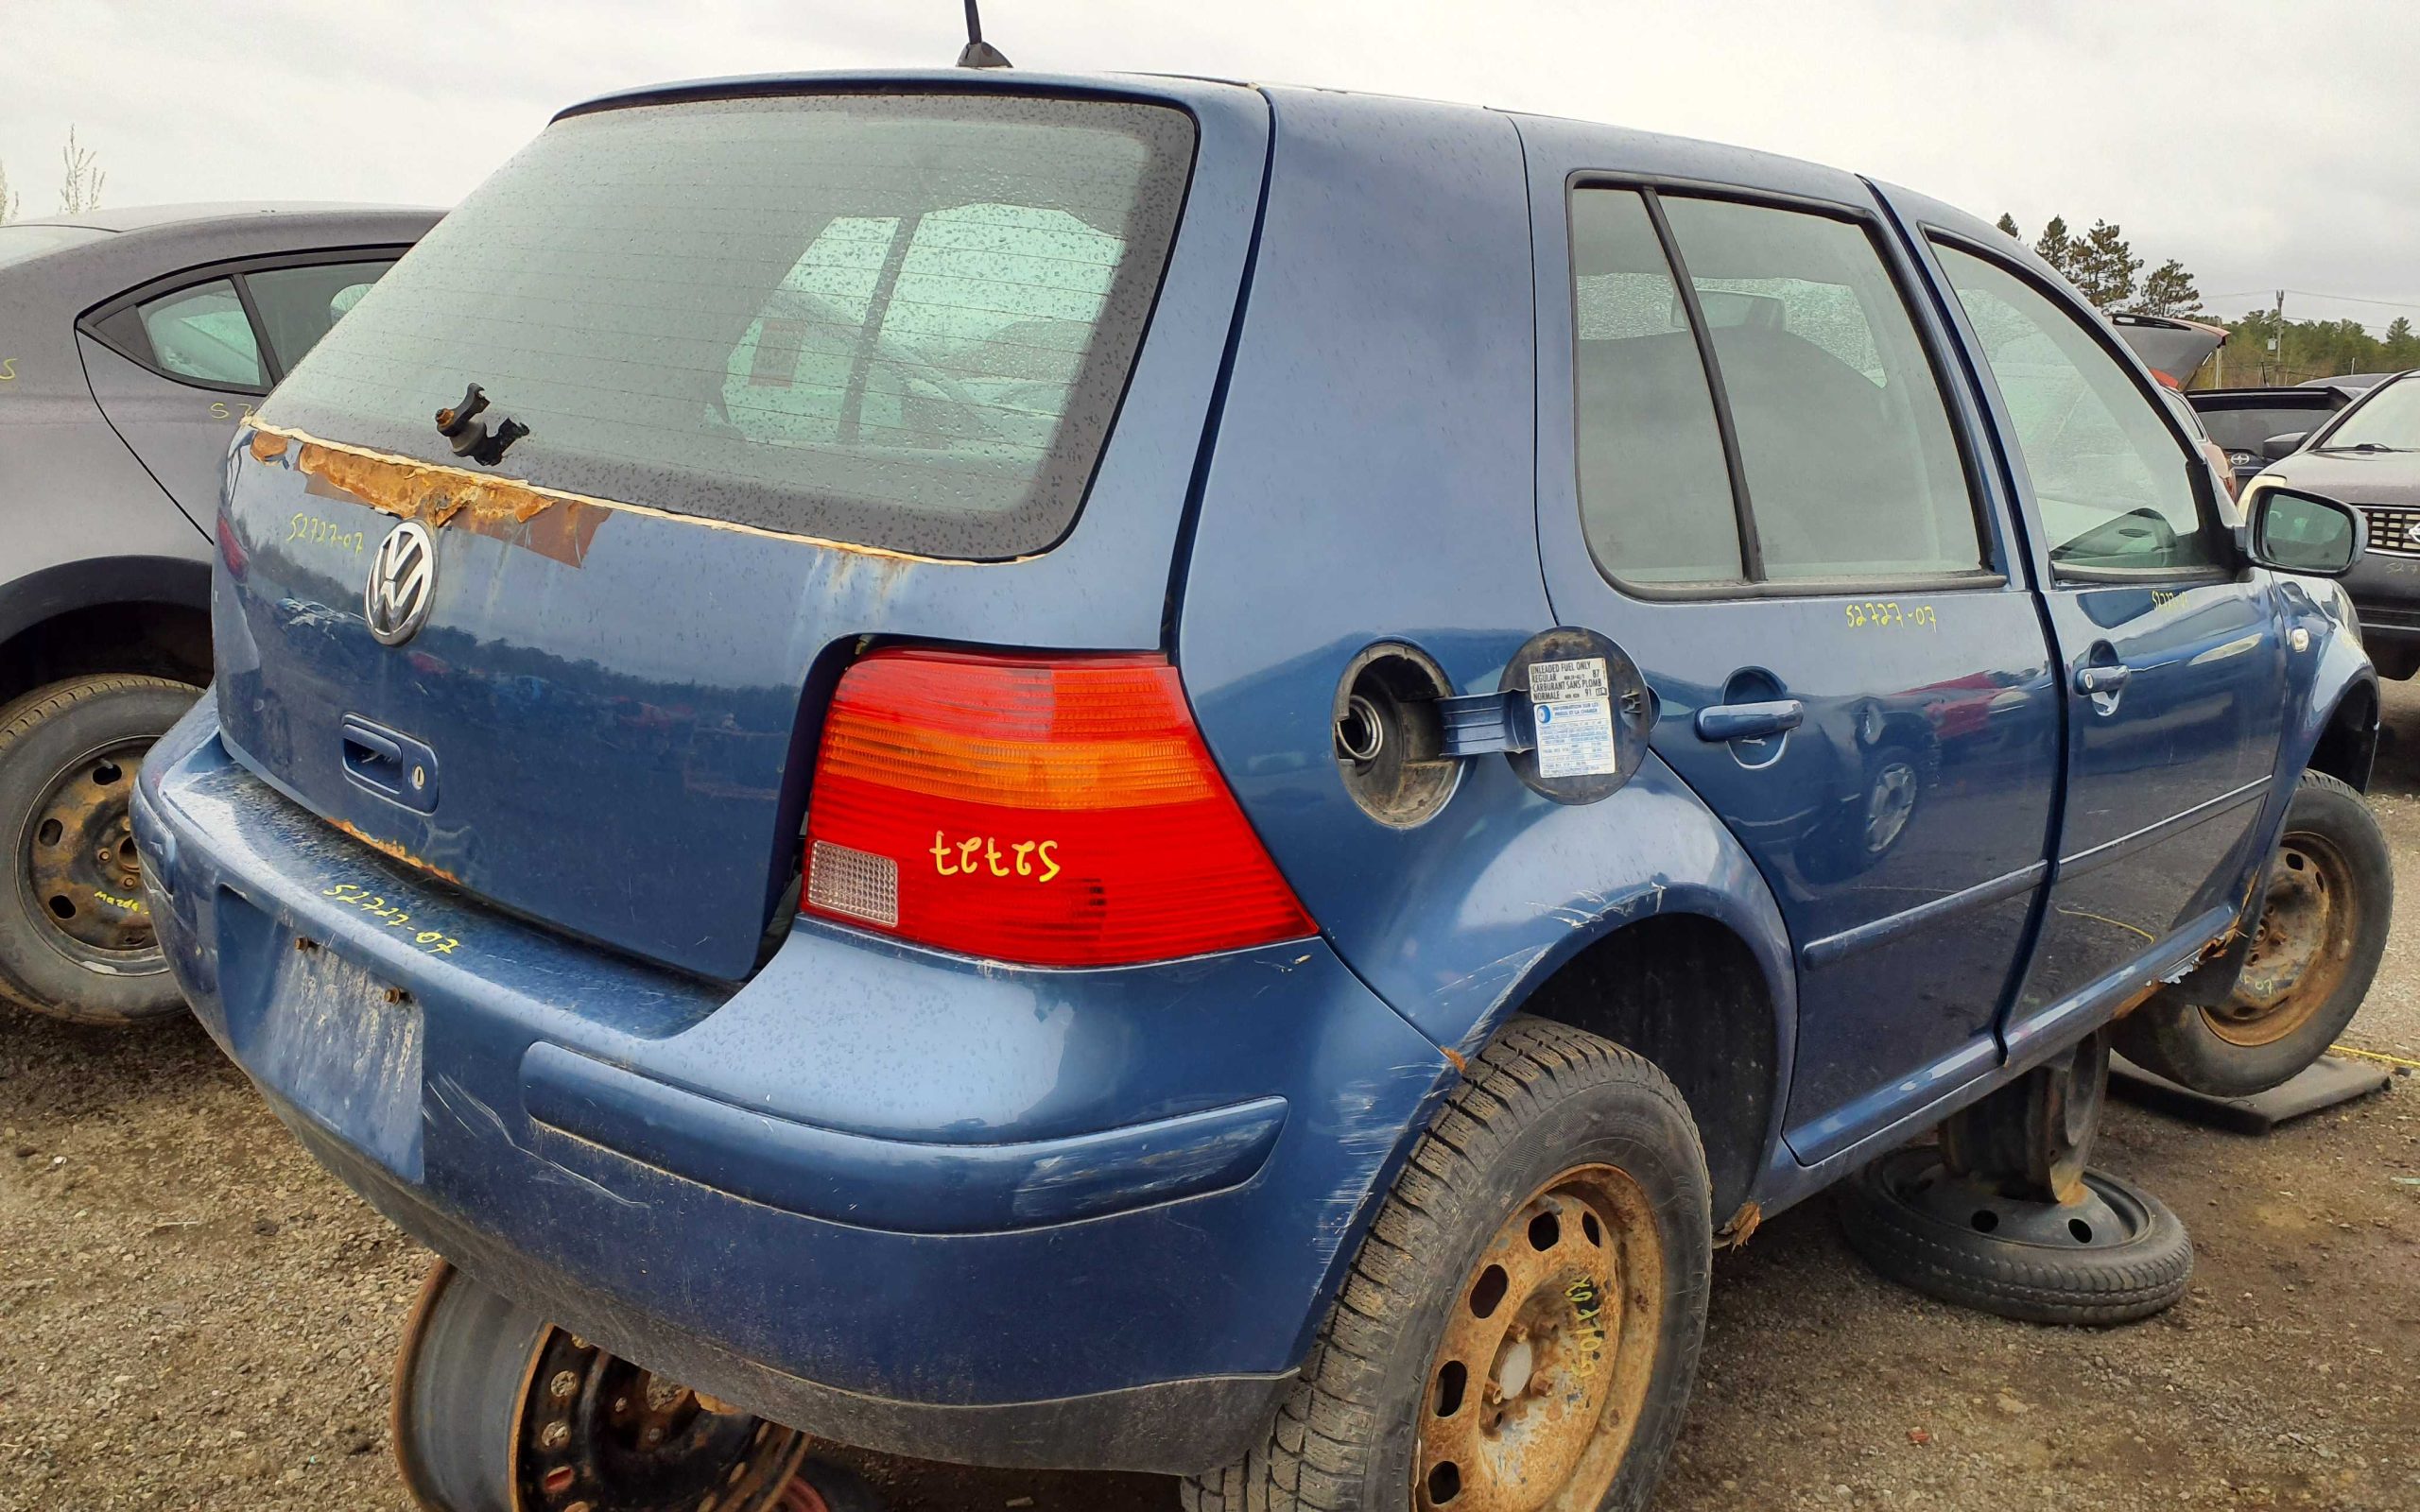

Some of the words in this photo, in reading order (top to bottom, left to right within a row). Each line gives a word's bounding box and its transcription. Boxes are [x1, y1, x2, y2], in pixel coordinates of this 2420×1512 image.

[1845, 602, 1937, 633] 52727-07
[1531, 664, 1560, 675] UNLEADED
[1561, 663, 1575, 672] FUEL
[1576, 661, 1591, 670] ONLY
[1532, 674, 1557, 682] REGULAR
[1592, 669, 1599, 679] 87
[1532, 681, 1565, 693] CARBURANT
[1566, 680, 1582, 690] SANS
[1582, 679, 1601, 689] PLOMB
[1533, 692, 1560, 701] NORMALE
